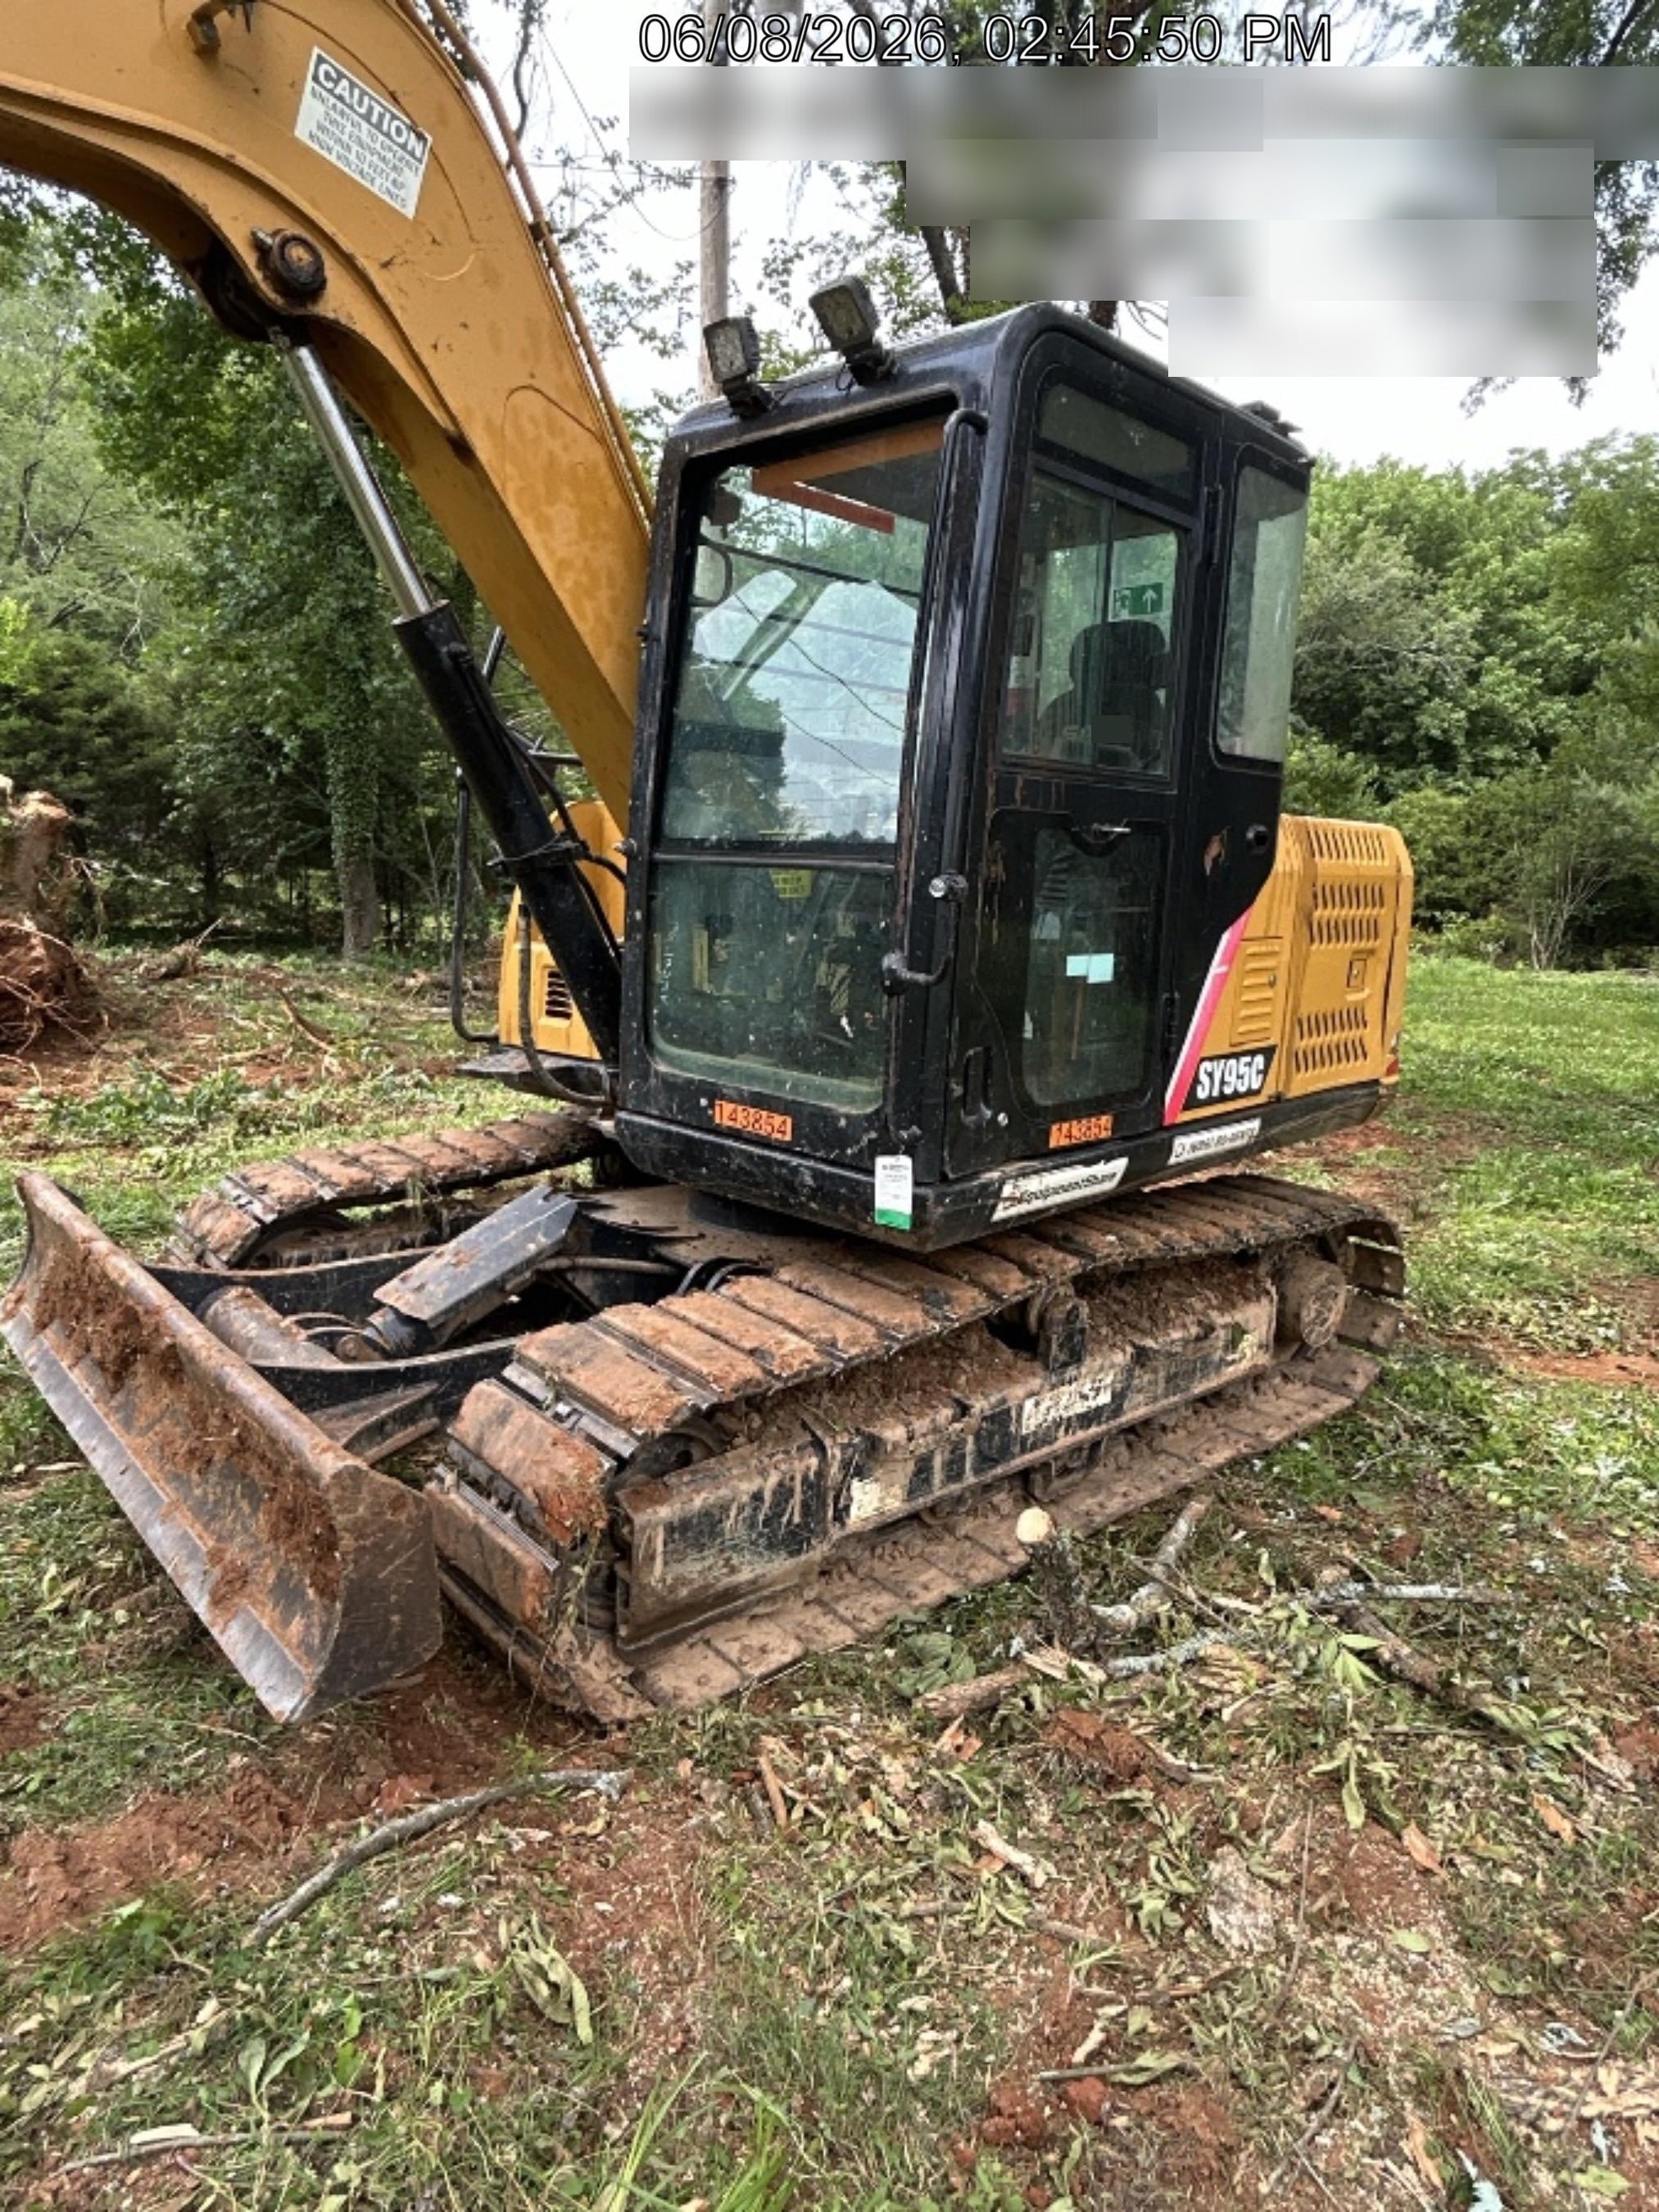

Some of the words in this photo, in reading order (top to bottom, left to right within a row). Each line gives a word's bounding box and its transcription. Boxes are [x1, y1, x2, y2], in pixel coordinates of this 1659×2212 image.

[318, 62, 424, 159] CAUTION
[1196, 1053, 1265, 1100] SY95C
[717, 1103, 787, 1138] 143854
